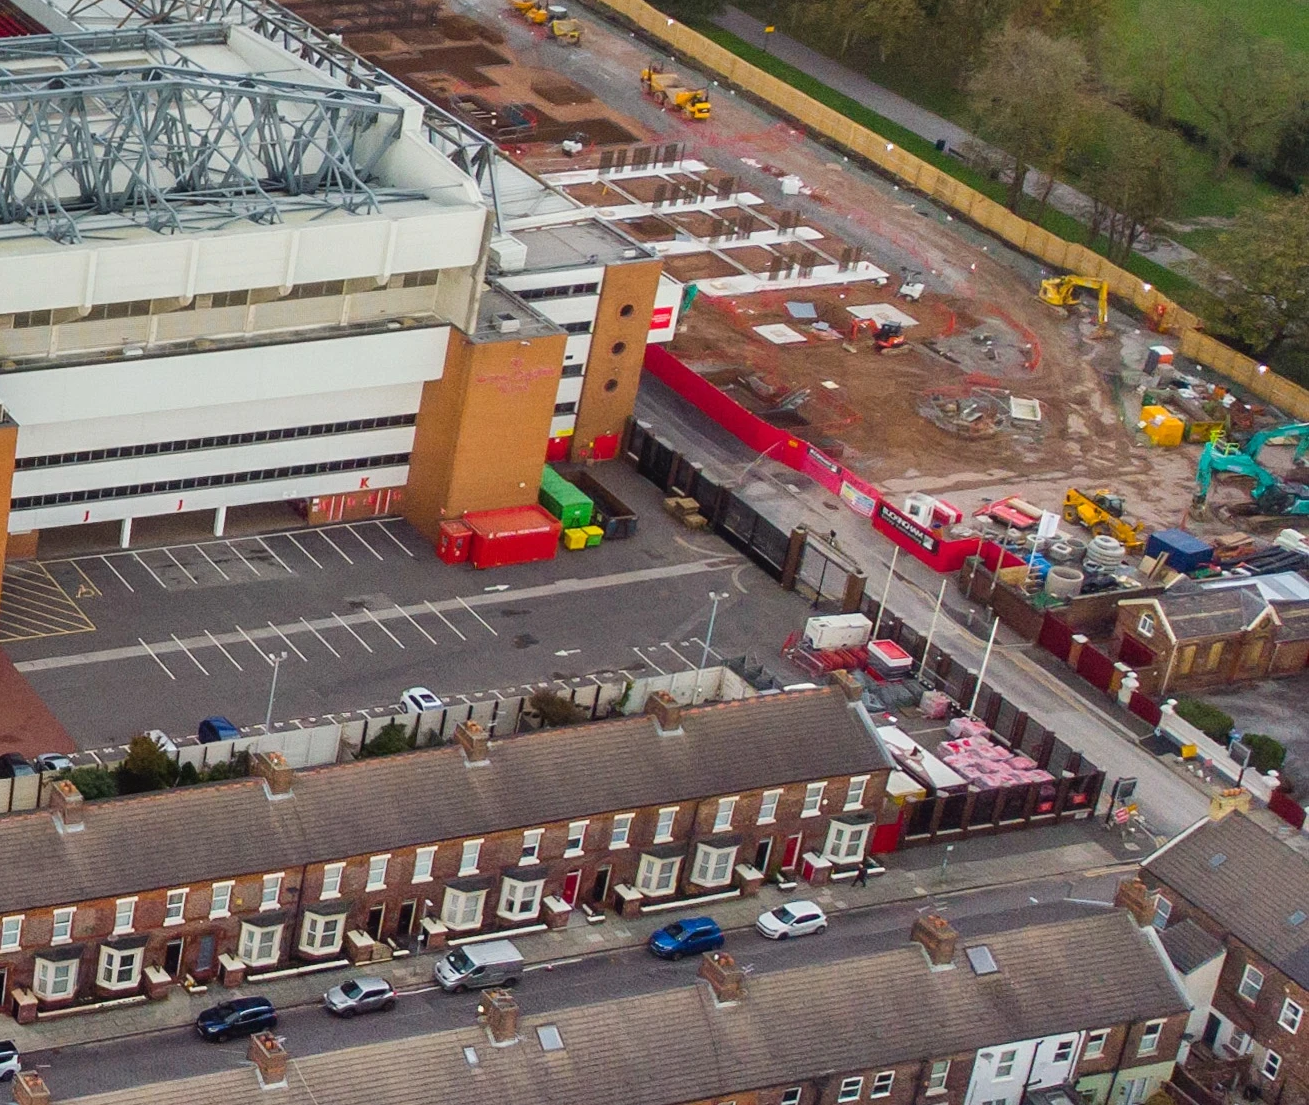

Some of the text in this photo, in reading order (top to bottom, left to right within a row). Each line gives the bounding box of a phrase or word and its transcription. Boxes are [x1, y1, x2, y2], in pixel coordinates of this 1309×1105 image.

[359, 477, 370, 488] K
[177, 499, 183, 511] J
[83, 510, 90, 522] J
